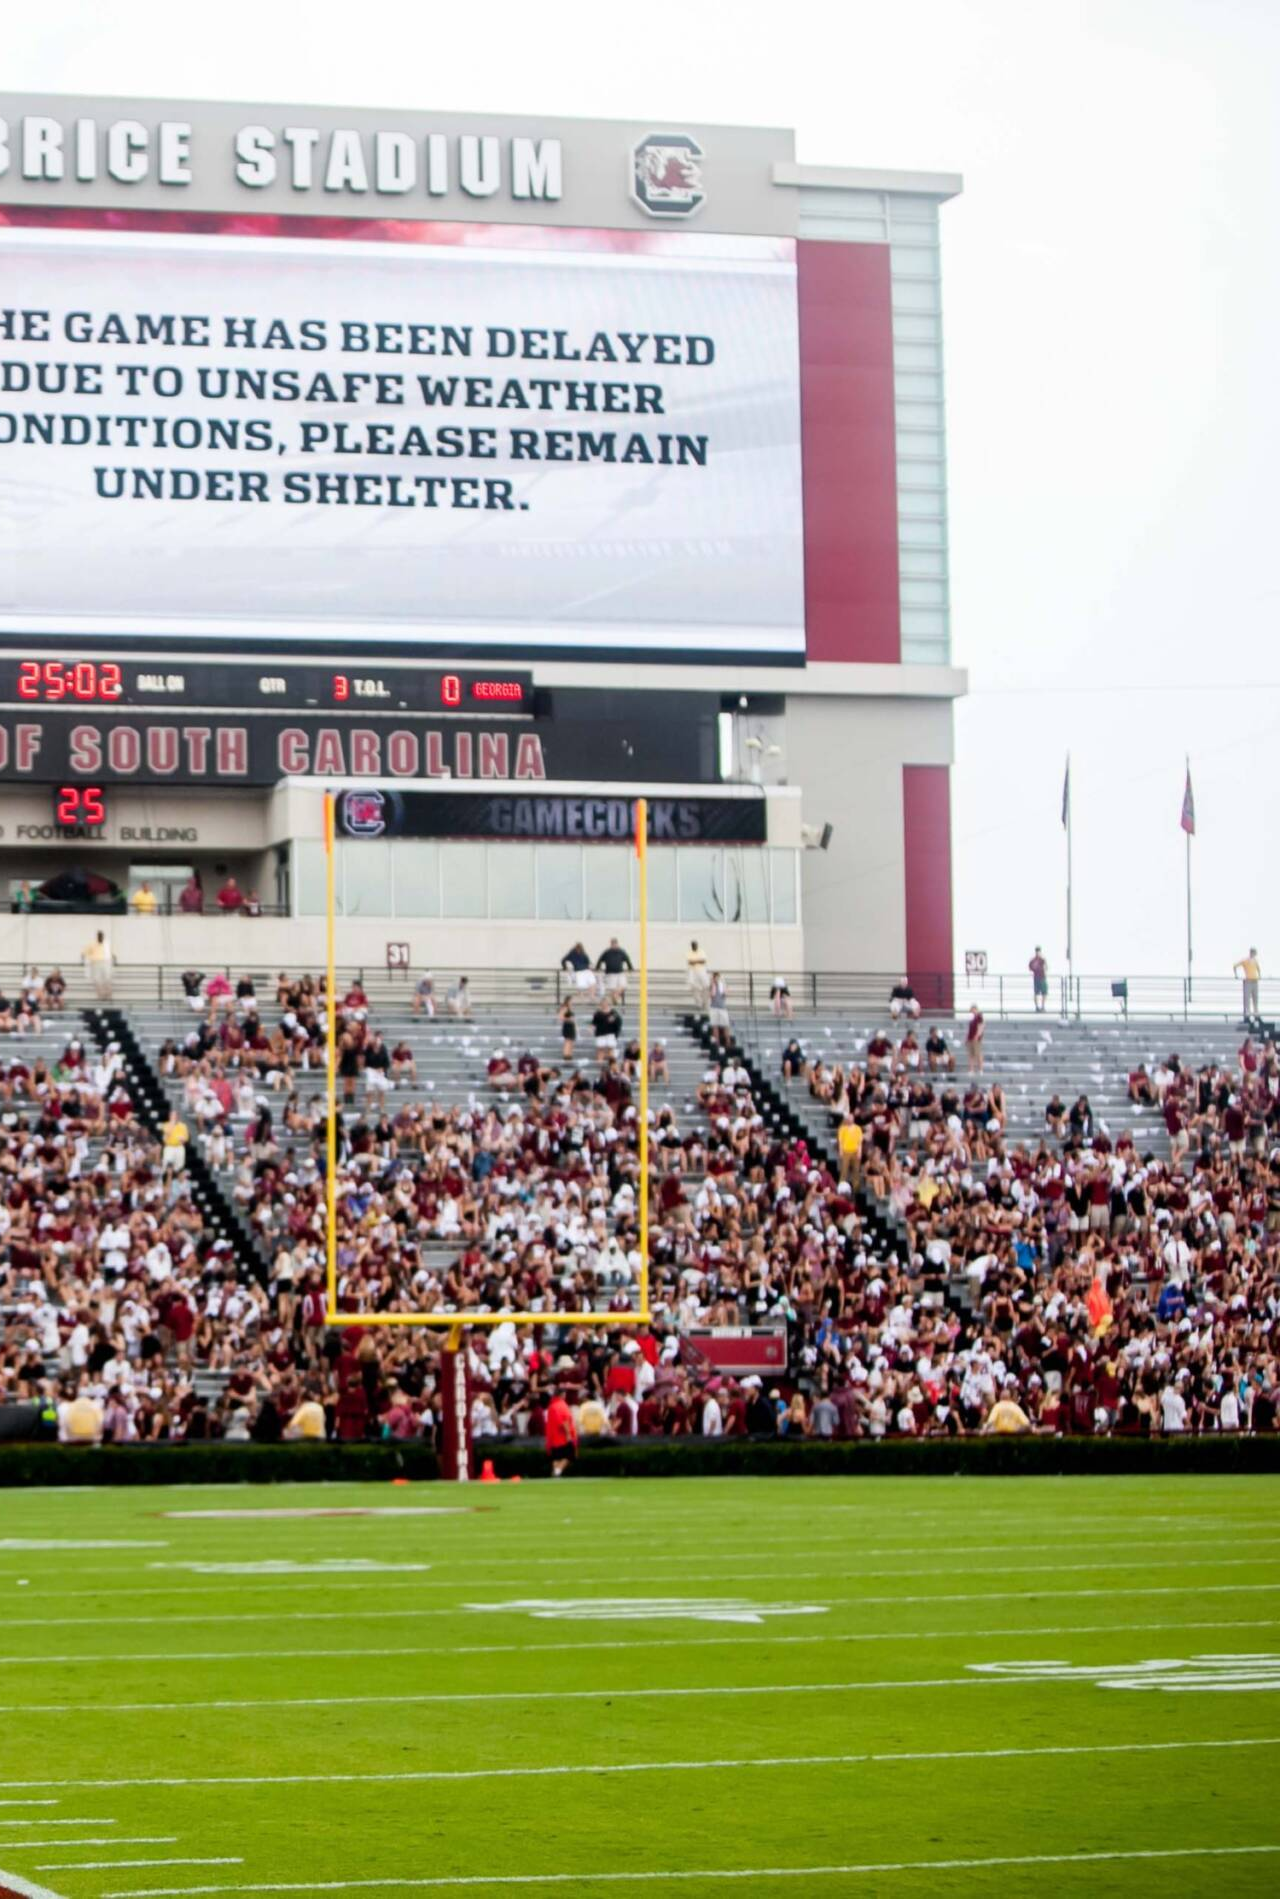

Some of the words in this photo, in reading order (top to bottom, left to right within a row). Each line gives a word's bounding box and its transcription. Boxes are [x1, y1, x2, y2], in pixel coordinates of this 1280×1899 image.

[234, 126, 564, 200] STADIUM
[64, 311, 210, 348] GAME
[224, 317, 327, 352] HAS
[340, 322, 473, 358] BEEN
[486, 327, 716, 366] DELAYED
[1, 361, 103, 395] DUE
[116, 365, 183, 398] TO
[197, 368, 404, 405] UNSAFE
[416, 375, 665, 415] WEATHER
[300, 421, 498, 460] PLEASE
[509, 427, 710, 466] REMAIN
[93, 467, 271, 503] UNDER
[283, 472, 530, 512] SHELTER.
[19, 662, 121, 700] 25:02
[333, 675, 349, 700] 3
[442, 675, 461, 704] 0
[473, 682, 522, 699] GEORGIA
[69, 725, 248, 775] SOUTH
[277, 727, 546, 780] CAROLINA
[57, 787, 106, 825] 25
[17, 825, 107, 841] FOOTBALL
[120, 827, 199, 843] BUILDING
[388, 944, 408, 963] 31
[966, 952, 987, 970] 30
